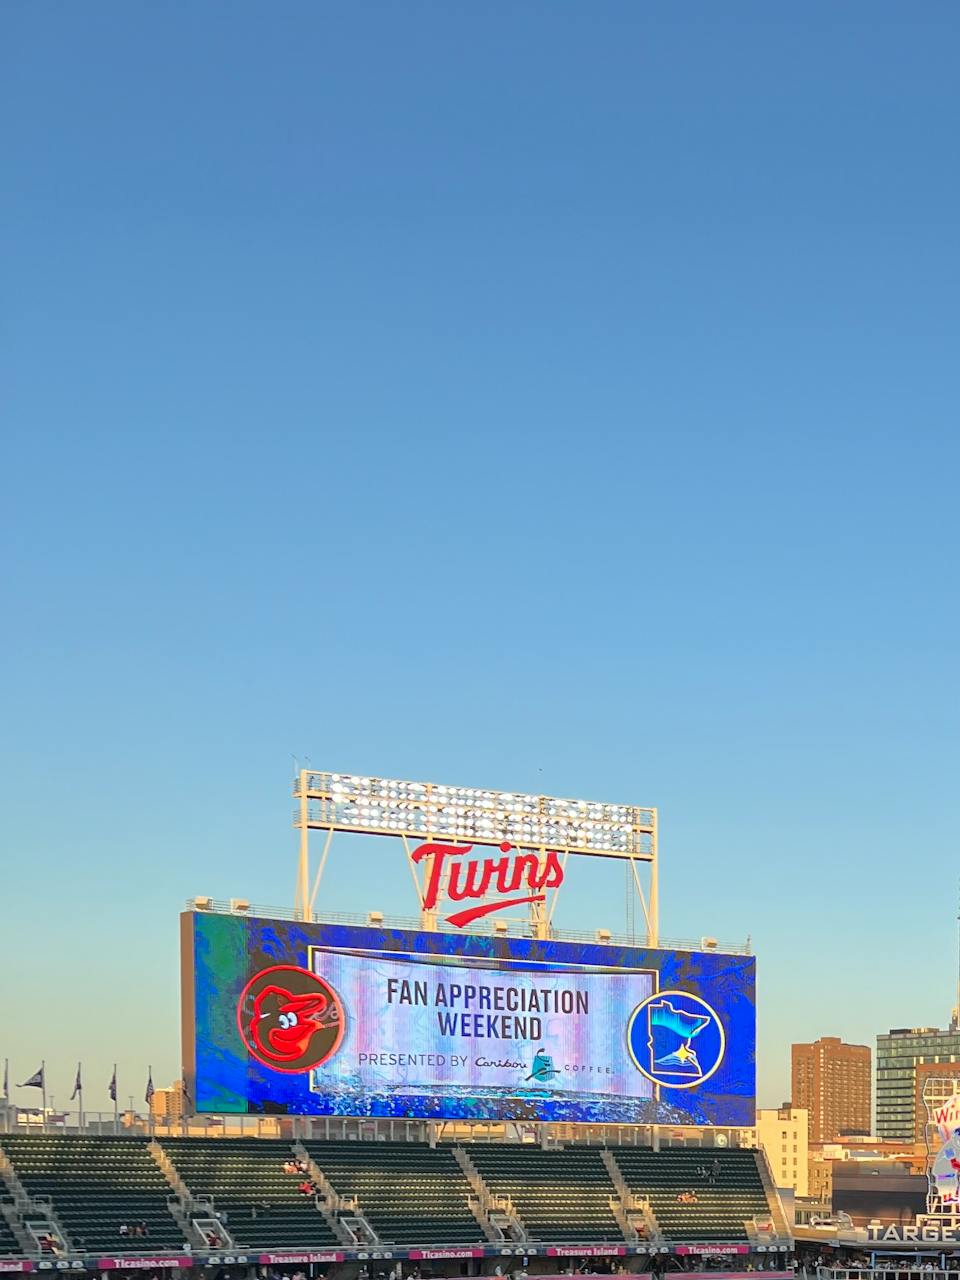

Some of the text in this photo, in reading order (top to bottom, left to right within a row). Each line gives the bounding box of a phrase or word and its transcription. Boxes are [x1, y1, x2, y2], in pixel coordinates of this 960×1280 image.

[412, 842, 563, 911] Twins
[387, 978, 589, 1014] FAN APPRECIATION
[438, 1012, 542, 1040] WEEKEND
[358, 1053, 445, 1066] PRESENTED
[450, 1055, 468, 1067] BY
[475, 1057, 527, 1069] Caribou
[270, 1253, 337, 1263] Treasure Island
[556, 1248, 618, 1257] Treasure Island
